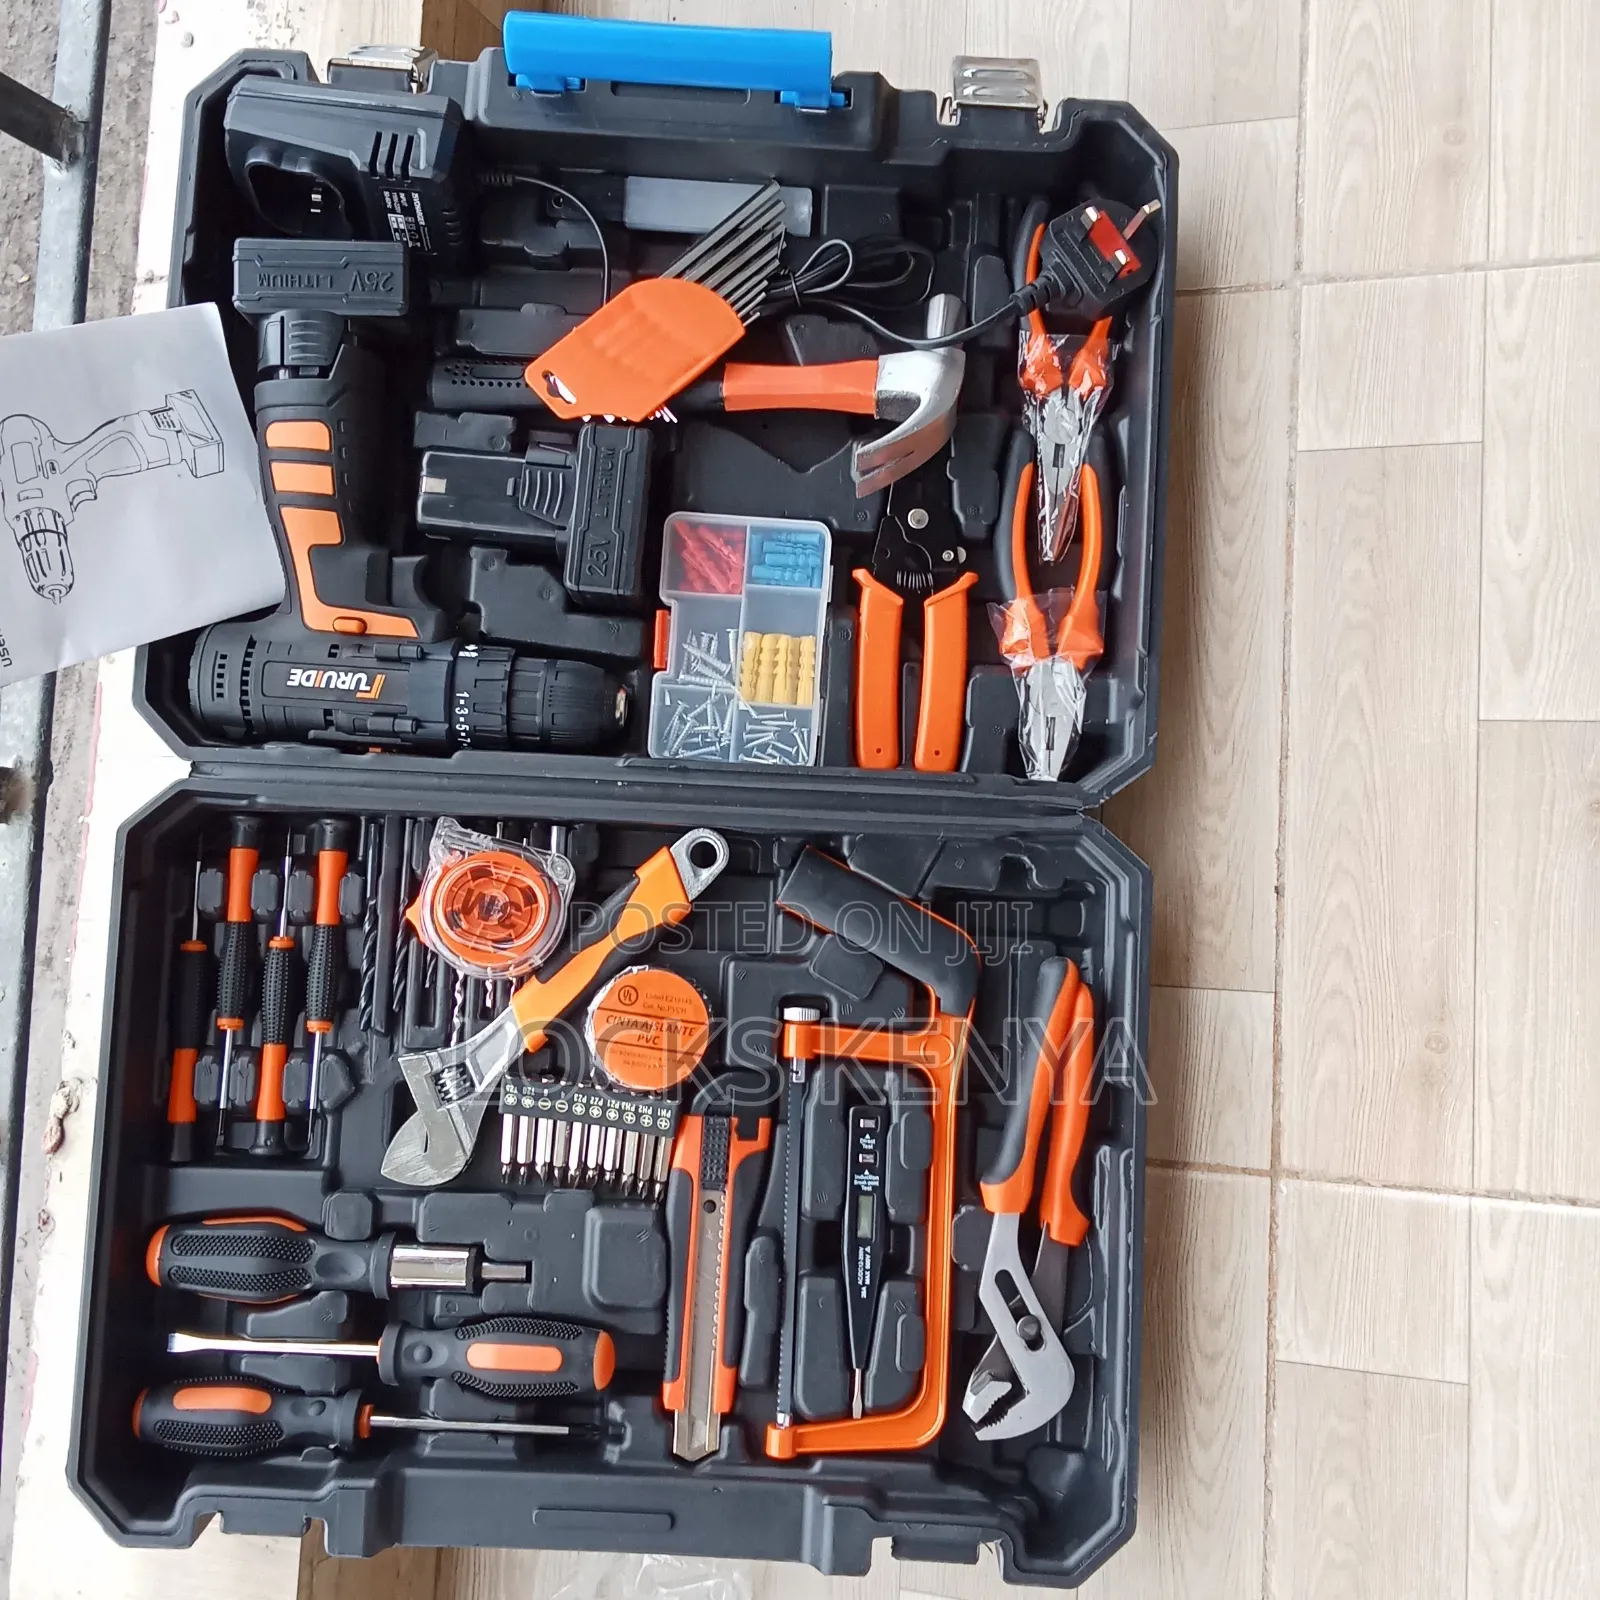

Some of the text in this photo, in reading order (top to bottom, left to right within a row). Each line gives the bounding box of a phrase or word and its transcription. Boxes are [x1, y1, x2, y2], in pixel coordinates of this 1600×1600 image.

[256, 271, 333, 289] LITHIUM
[586, 445, 617, 578] 25V LITHIUM
[605, 1014, 697, 1037] CINTA AISLANTE
[636, 1033, 661, 1046] PVC
